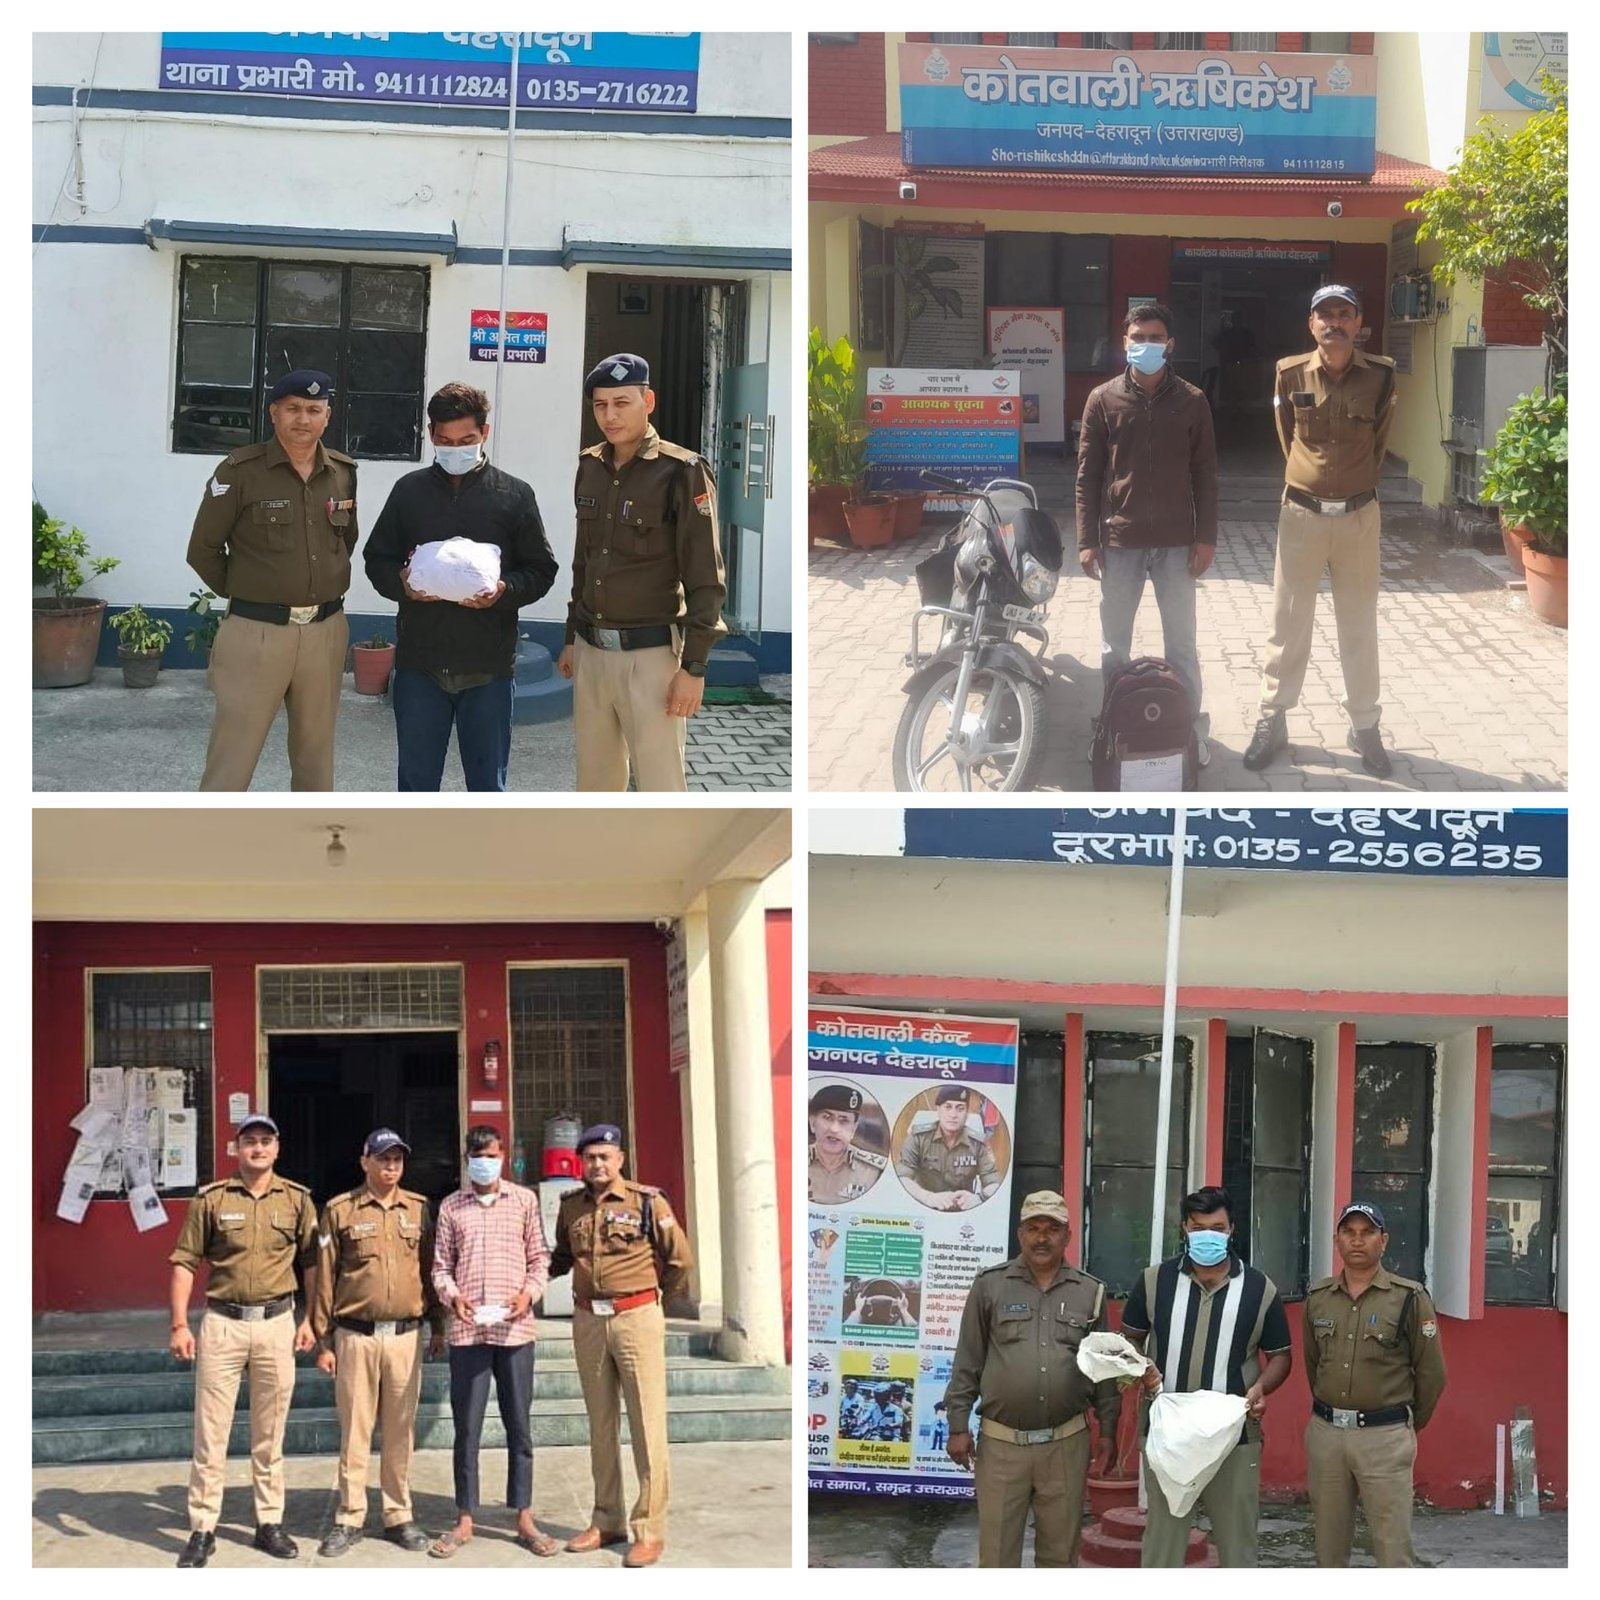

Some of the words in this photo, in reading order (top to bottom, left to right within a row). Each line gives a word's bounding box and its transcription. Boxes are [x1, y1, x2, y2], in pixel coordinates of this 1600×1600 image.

[166, 62, 230, 86] थाना
[236, 58, 316, 91] प्रभारी
[321, 61, 365, 92] मो.
[374, 71, 508, 99] 9411112824
[526, 78, 690, 106] 0135-2716222
[961, 54, 1144, 108] कोतवाली
[1149, 59, 1317, 111] ऋषिकेश
[1036, 120, 1152, 146] जनपद-देहरादून
[1156, 121, 1245, 146] (उत्तराखण्ड)
[1282, 159, 1345, 170] 9411112815
[472, 328, 487, 342] श्री
[523, 331, 546, 345] शर्मा
[478, 348, 499, 360] थान
[506, 347, 539, 362] प्रभारी
[901, 398, 950, 410] आवश्यक
[953, 399, 985, 413] सूचना
[815, 1016, 915, 1043] कोतवाली
[920, 1023, 972, 1047] कैन्ट
[808, 1046, 880, 1066] जनपद
[884, 1046, 969, 1078] देहरादून
[808, 1413, 827, 1431] P
[826, 1478, 871, 1493] समाज,
[875, 1481, 912, 1497] समृद्ध
[914, 1484, 977, 1498] उत्तराखण्ड
